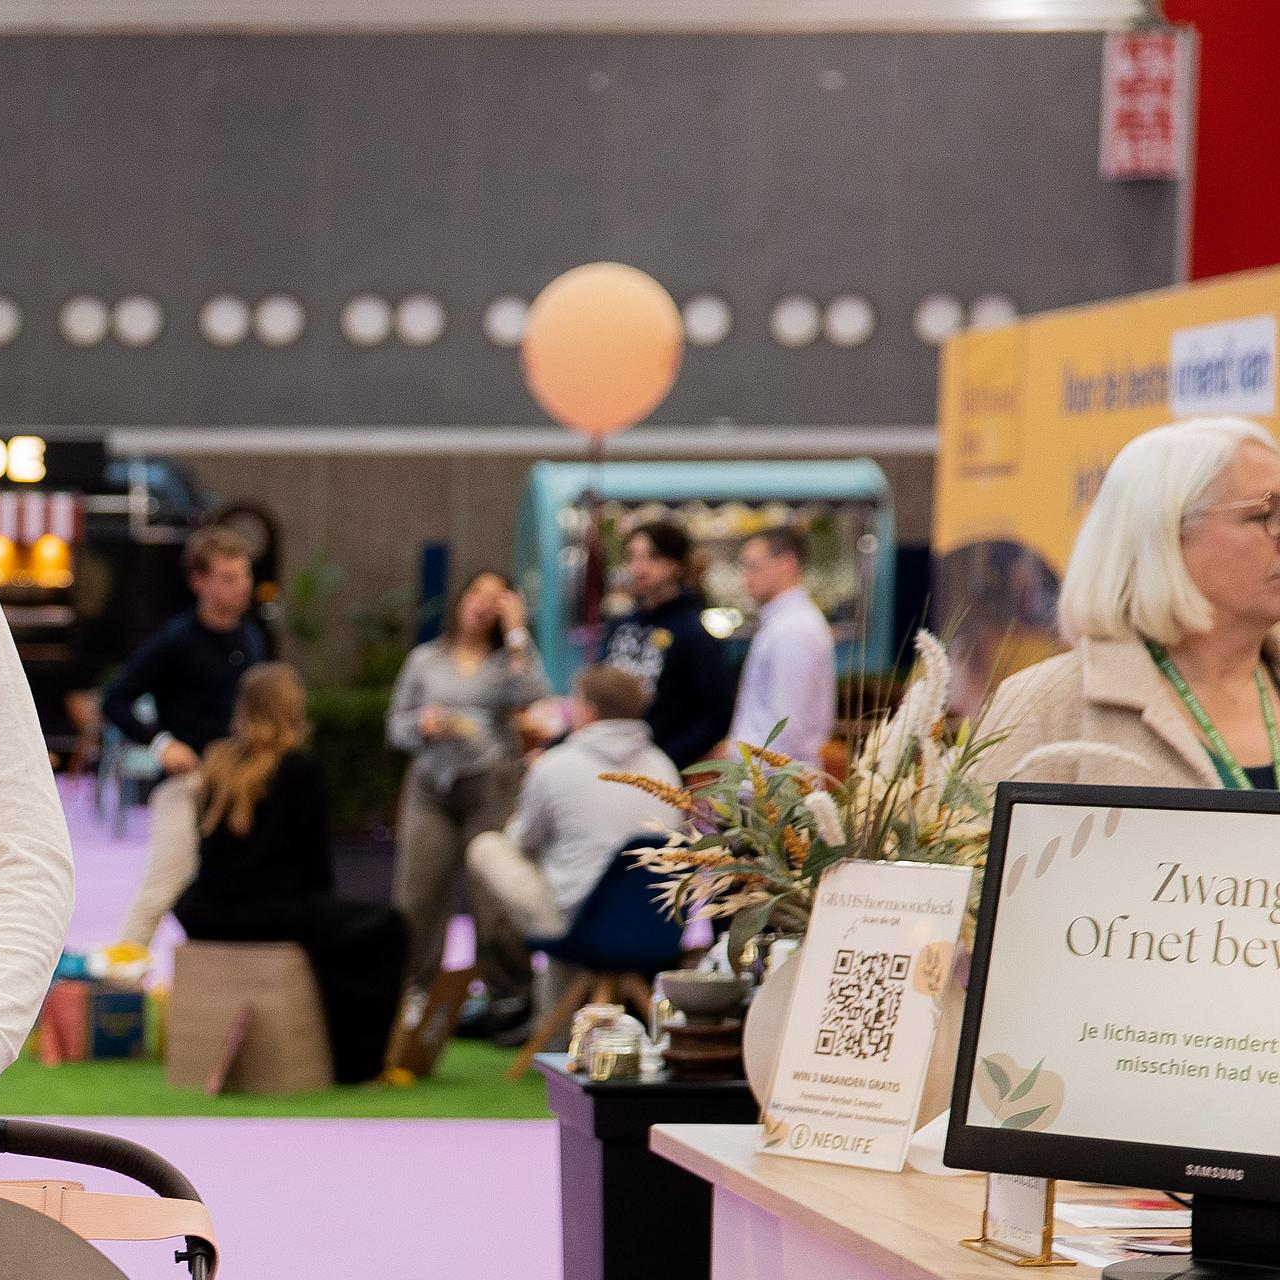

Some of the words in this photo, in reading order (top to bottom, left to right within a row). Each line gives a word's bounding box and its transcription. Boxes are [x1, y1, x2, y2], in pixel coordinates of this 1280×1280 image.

[1066, 914, 1130, 958] Of
[1127, 927, 1203, 964] net
[1079, 1022, 1098, 1042] Je
[1103, 1022, 1177, 1046] lichaam
[1183, 1033, 1279, 1053] verandert
[792, 1071, 811, 1082] WIN
[812, 1072, 818, 1083] 3
[820, 1073, 866, 1089] MAANDEN
[868, 1079, 901, 1093] GRATIS
[1116, 1056, 1209, 1079] misschien
[1215, 1062, 1251, 1082] had
[1257, 1068, 1280, 1084] ve
[812, 1131, 874, 1154] NEOLIFE
[1185, 1164, 1245, 1181] SAMSUNG
